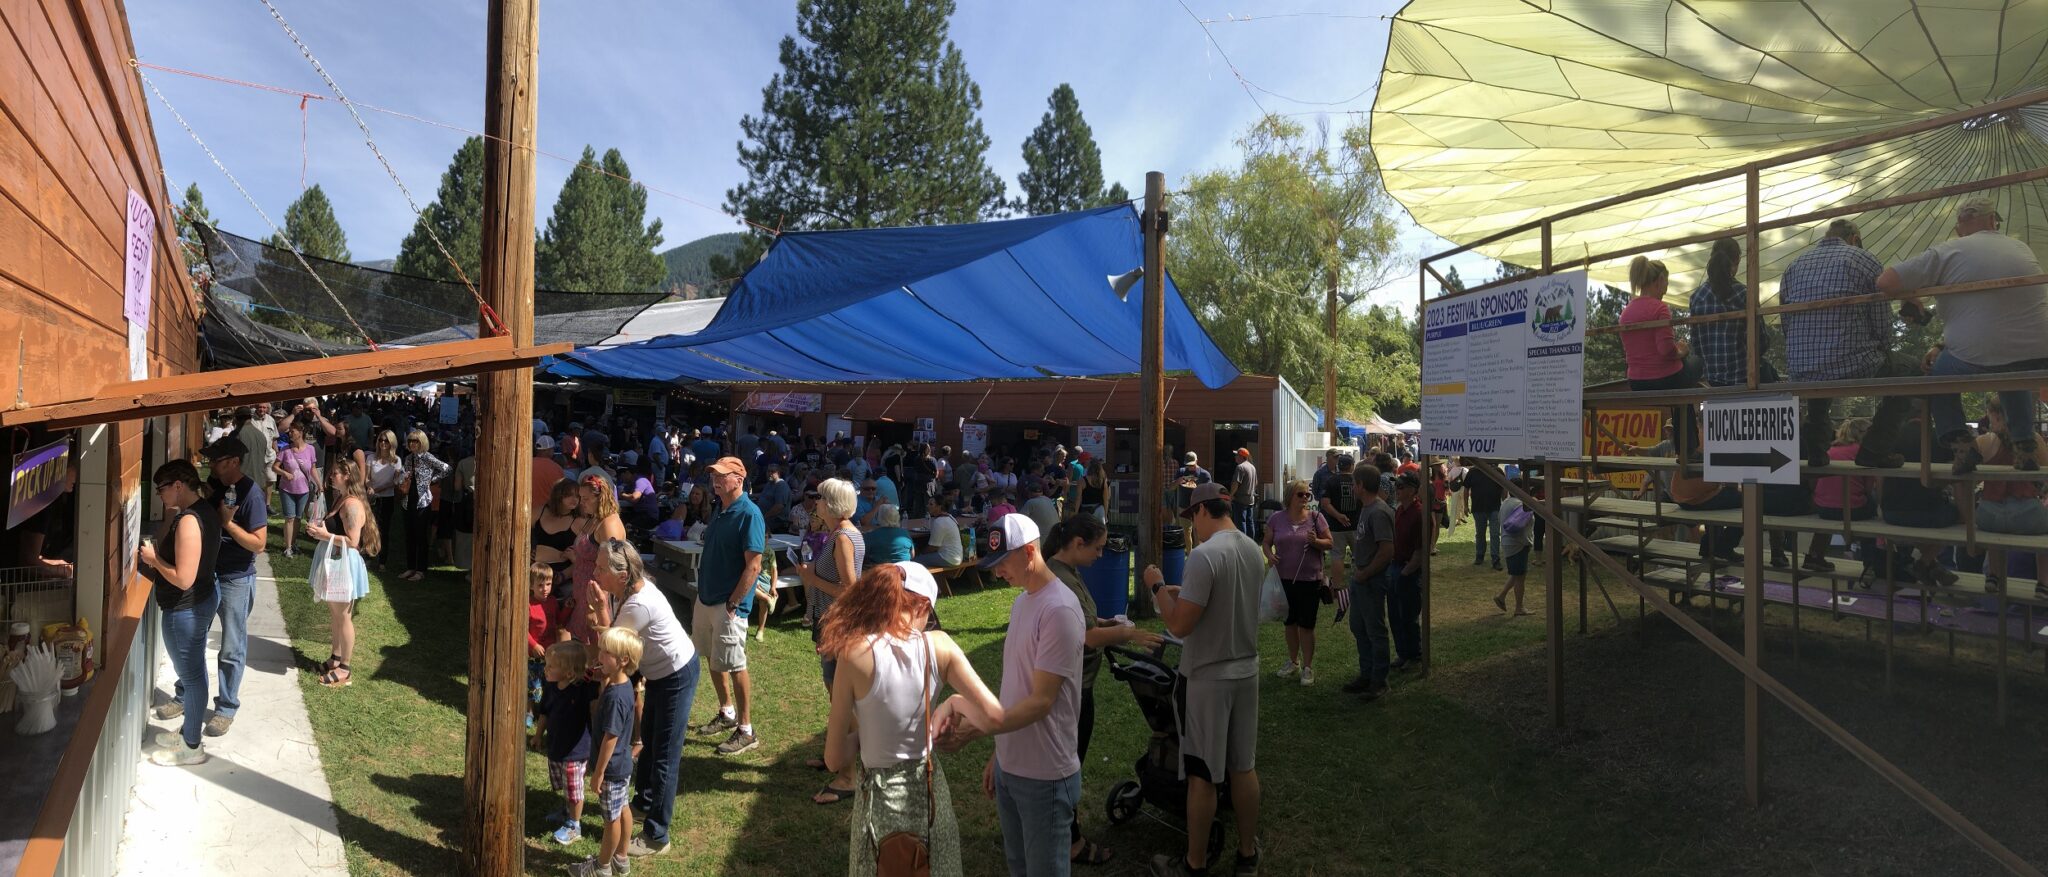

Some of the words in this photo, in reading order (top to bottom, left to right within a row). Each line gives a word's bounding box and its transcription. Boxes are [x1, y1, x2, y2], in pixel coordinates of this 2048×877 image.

[1427, 307, 1445, 328] 2023
[1447, 299, 1478, 324] FESTIVAL
[1481, 287, 1528, 317] SPONSORS
[1549, 345, 1571, 354] THANKS
[1584, 413, 1659, 439] UCTION
[1708, 406, 1794, 442] HUCKLEBERRIES
[1430, 437, 1465, 453] THANK
[1469, 439, 1495, 453] YOU!
[14, 463, 43, 507] PICK
